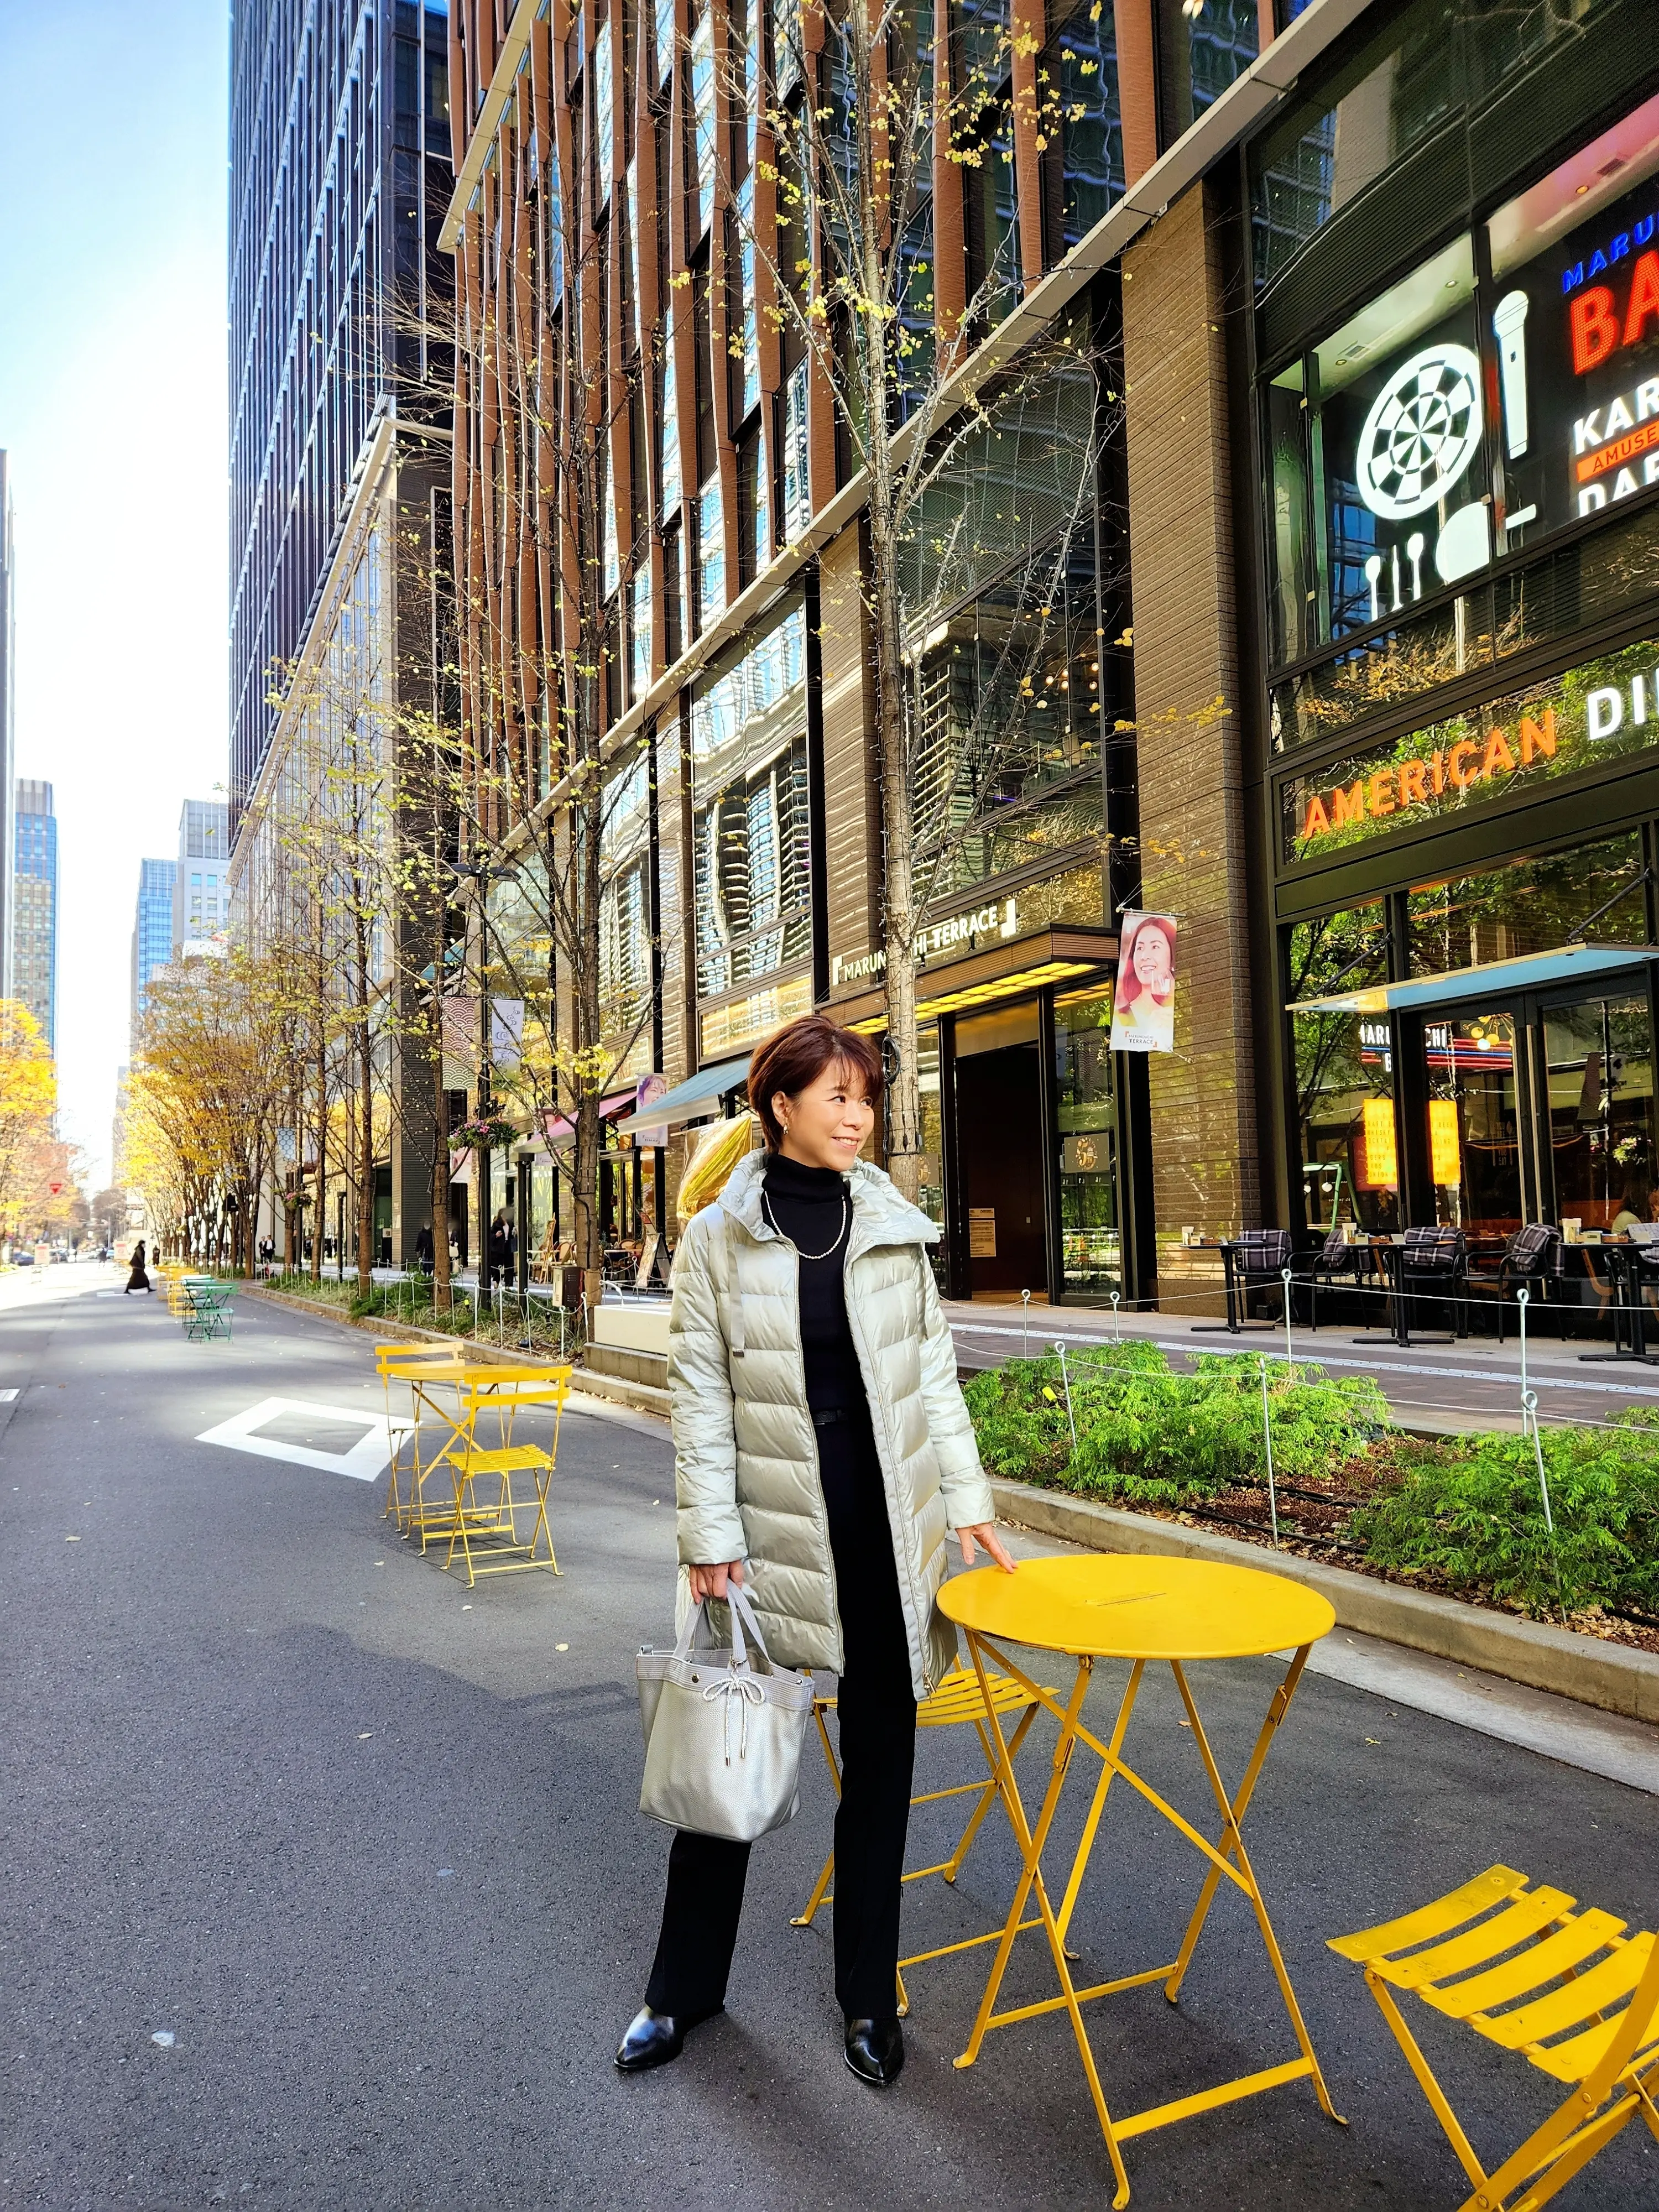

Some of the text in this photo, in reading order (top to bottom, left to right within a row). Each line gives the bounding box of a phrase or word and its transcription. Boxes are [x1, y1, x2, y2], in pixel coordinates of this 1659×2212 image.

[1562, 212, 1659, 294] MARU
[1593, 426, 1657, 472] AMUSE
[1303, 667, 1659, 839] AMERICAN DI
[844, 905, 998, 982] MARUNHI TERRACE
